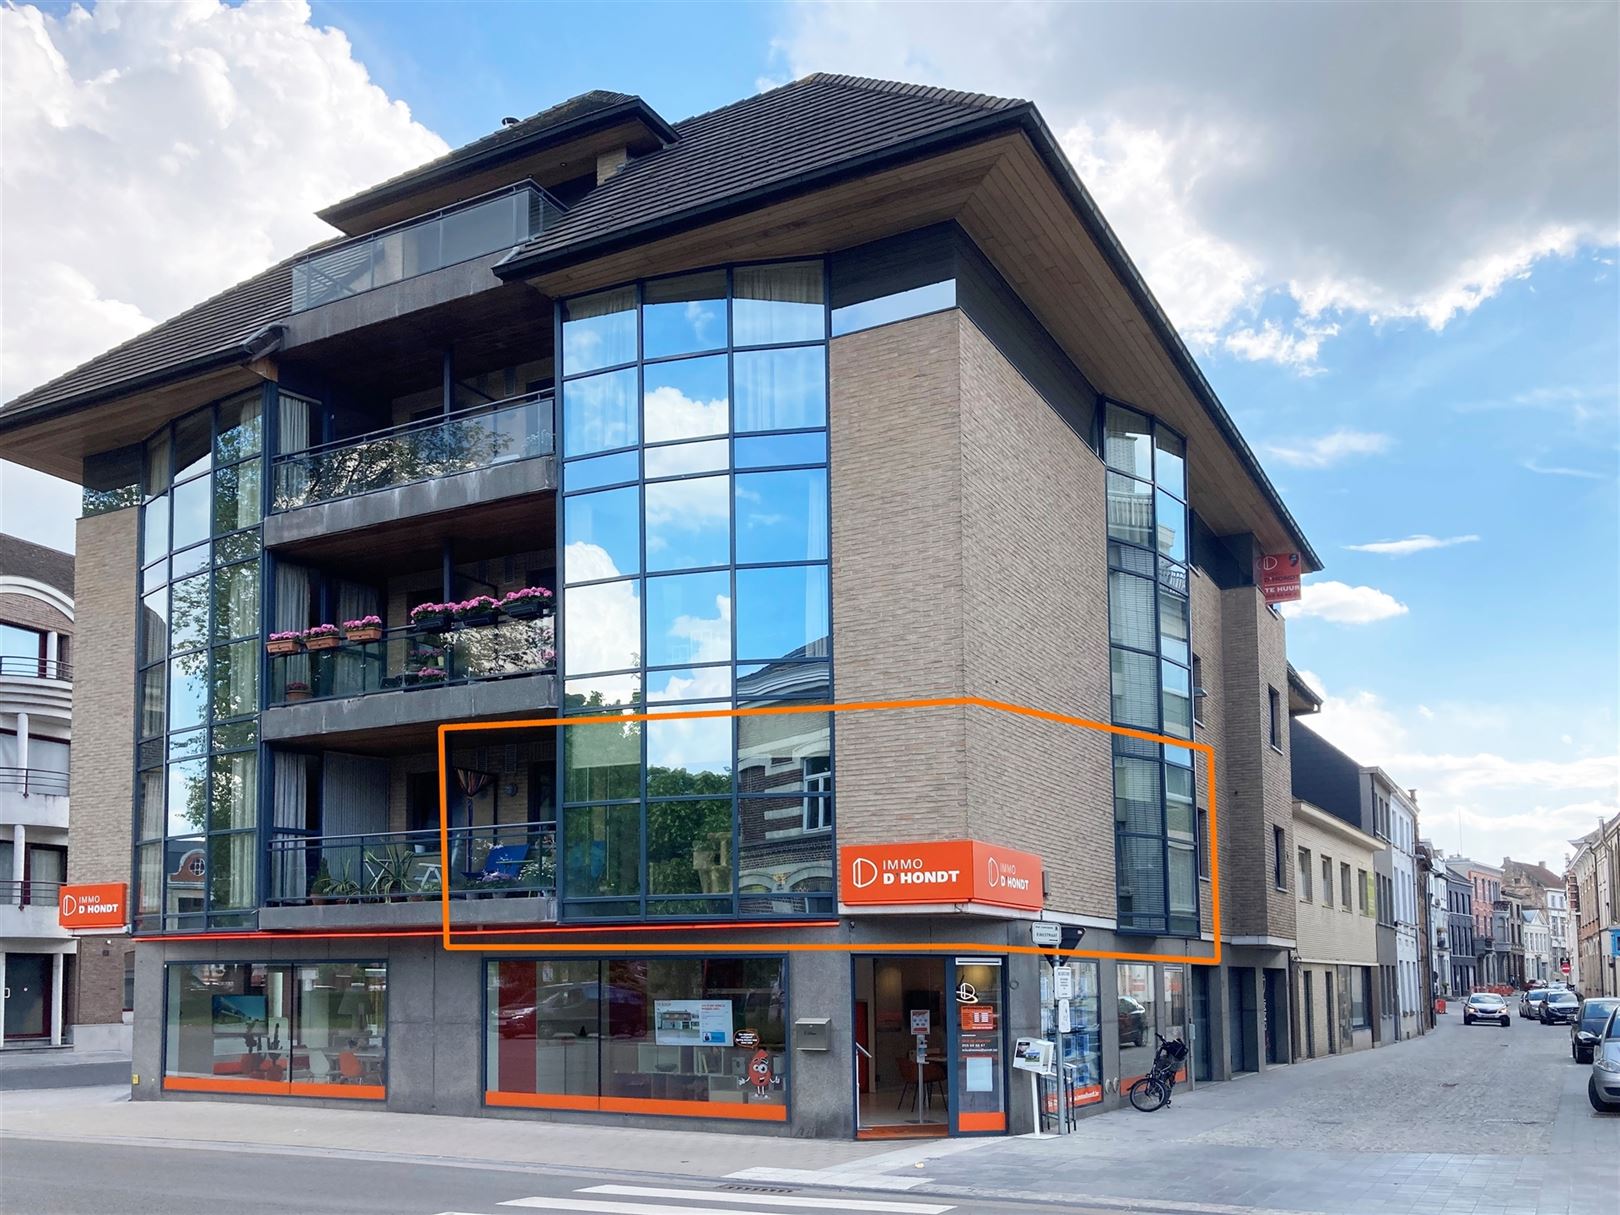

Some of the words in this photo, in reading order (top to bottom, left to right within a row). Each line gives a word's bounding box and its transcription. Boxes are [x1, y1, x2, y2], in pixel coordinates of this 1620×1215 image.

[882, 858, 923, 870] IMMO
[1000, 863, 1016, 875] IMMO
[883, 870, 960, 885] D'HONDT
[1000, 875, 1029, 890] D'HONDT
[79, 895, 101, 903] IMMO
